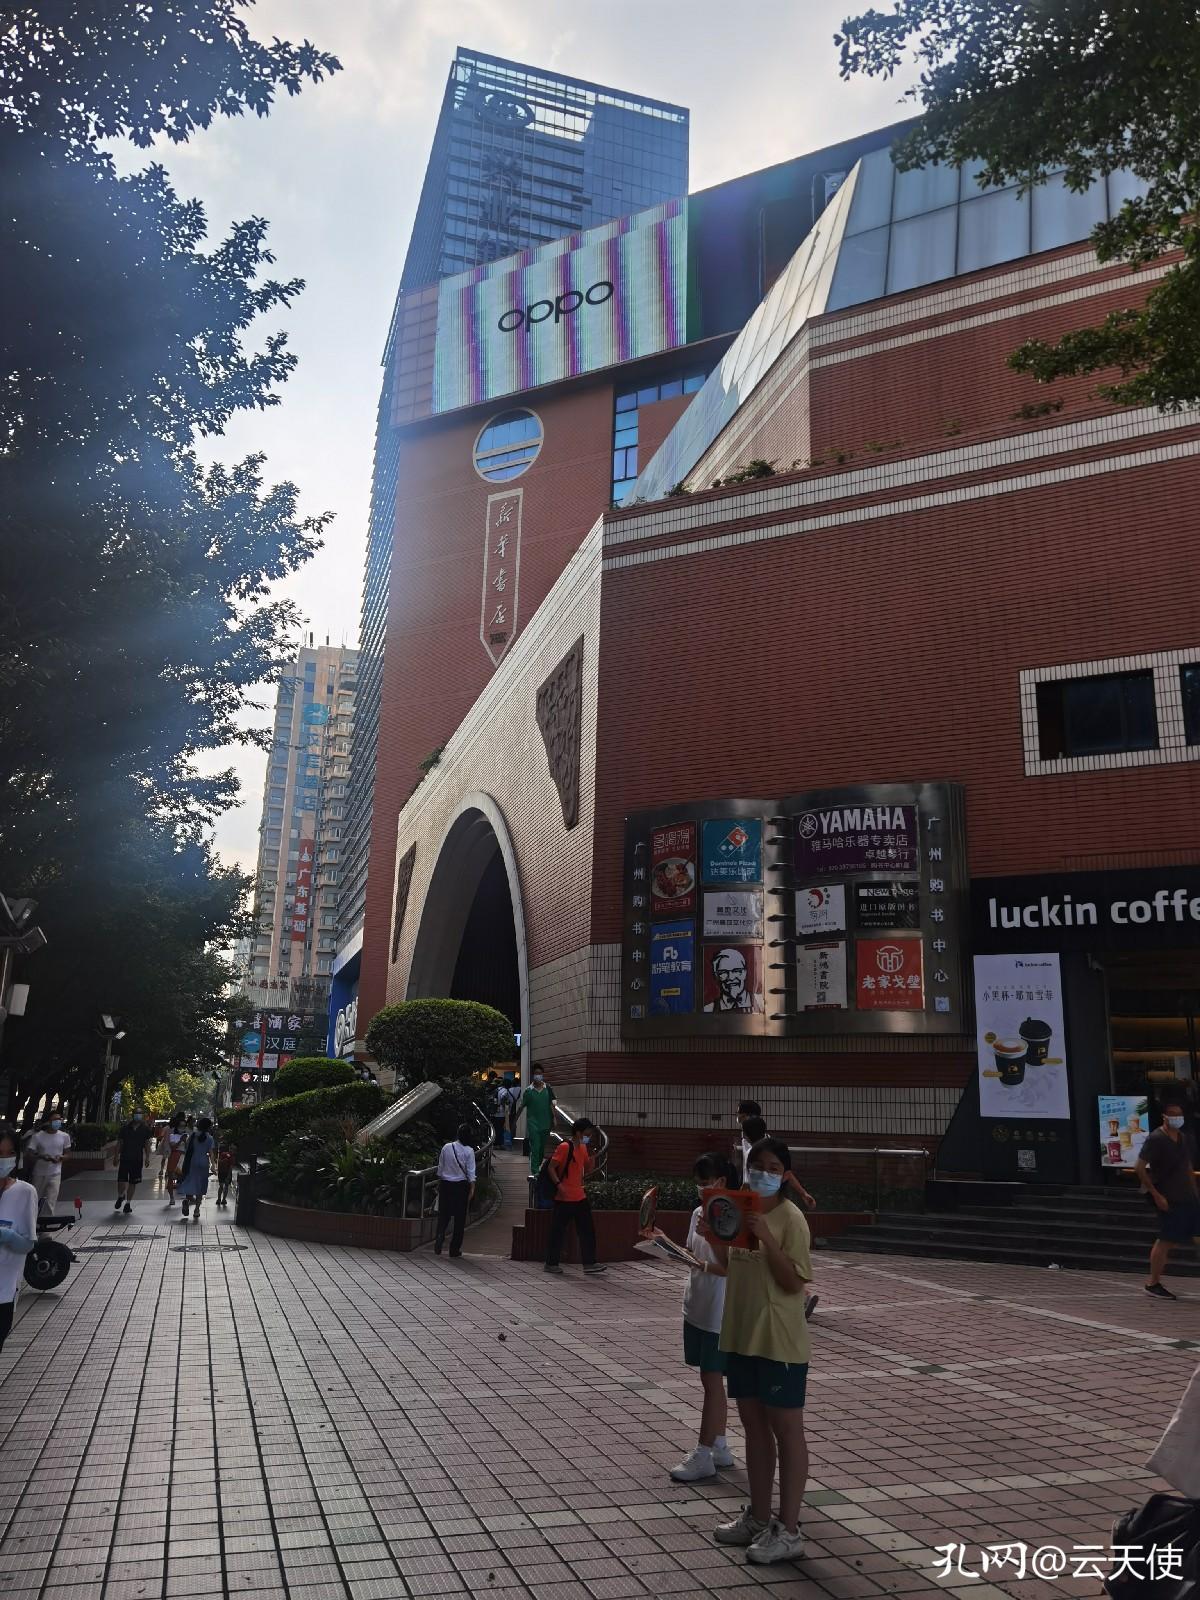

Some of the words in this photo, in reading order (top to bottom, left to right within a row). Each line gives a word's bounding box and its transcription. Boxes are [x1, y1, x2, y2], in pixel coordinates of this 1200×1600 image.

[819, 806, 906, 835] YAMAHA
[811, 834, 909, 853] 雅马哈乐器专卖店
[294, 868, 311, 932] 广东基础
[631, 841, 646, 991] 广州购书中心
[928, 817, 949, 983] 广州购书中心
[988, 893, 1098, 929] luckin
[862, 974, 921, 990] 老家戈壁
